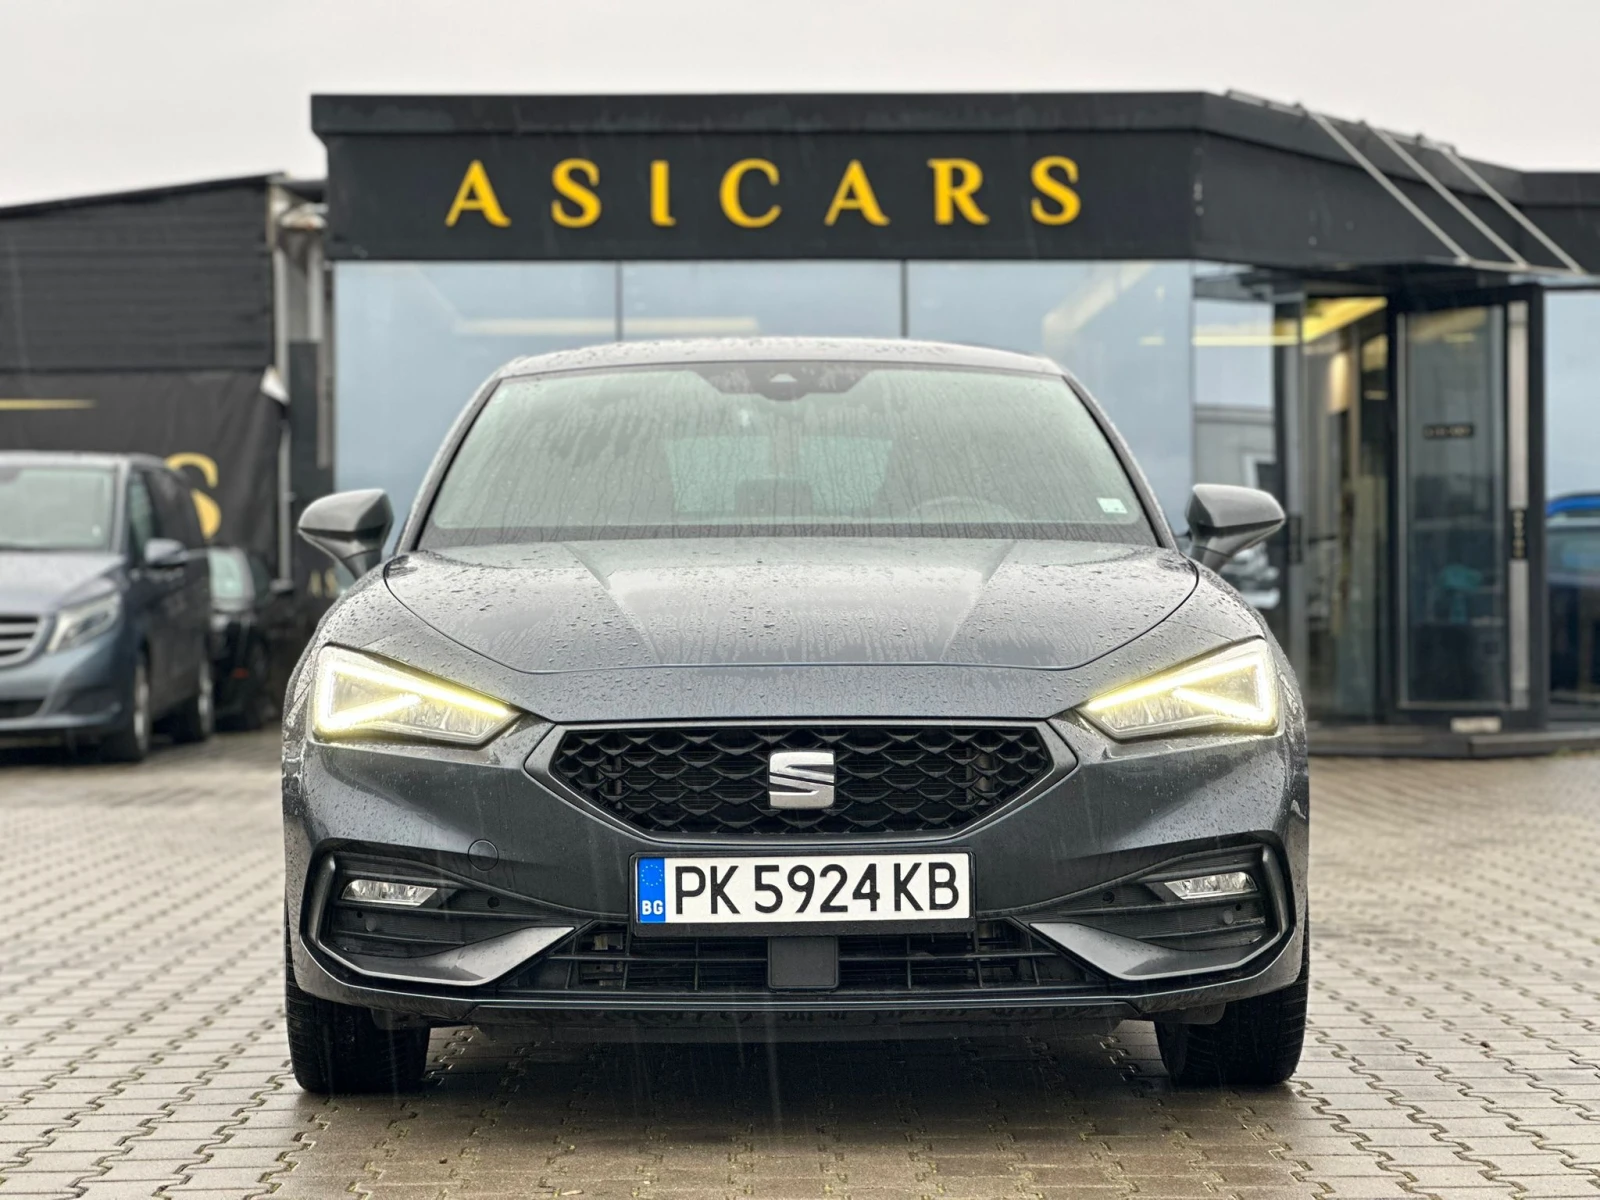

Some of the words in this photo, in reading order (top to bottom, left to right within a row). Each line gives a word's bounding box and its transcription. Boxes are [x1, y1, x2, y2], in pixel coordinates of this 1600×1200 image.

[445, 157, 1081, 228] ASICARS
[641, 899, 664, 915] BG
[675, 865, 741, 915] PK
[754, 863, 880, 914] 5924
[893, 862, 959, 912] KB
